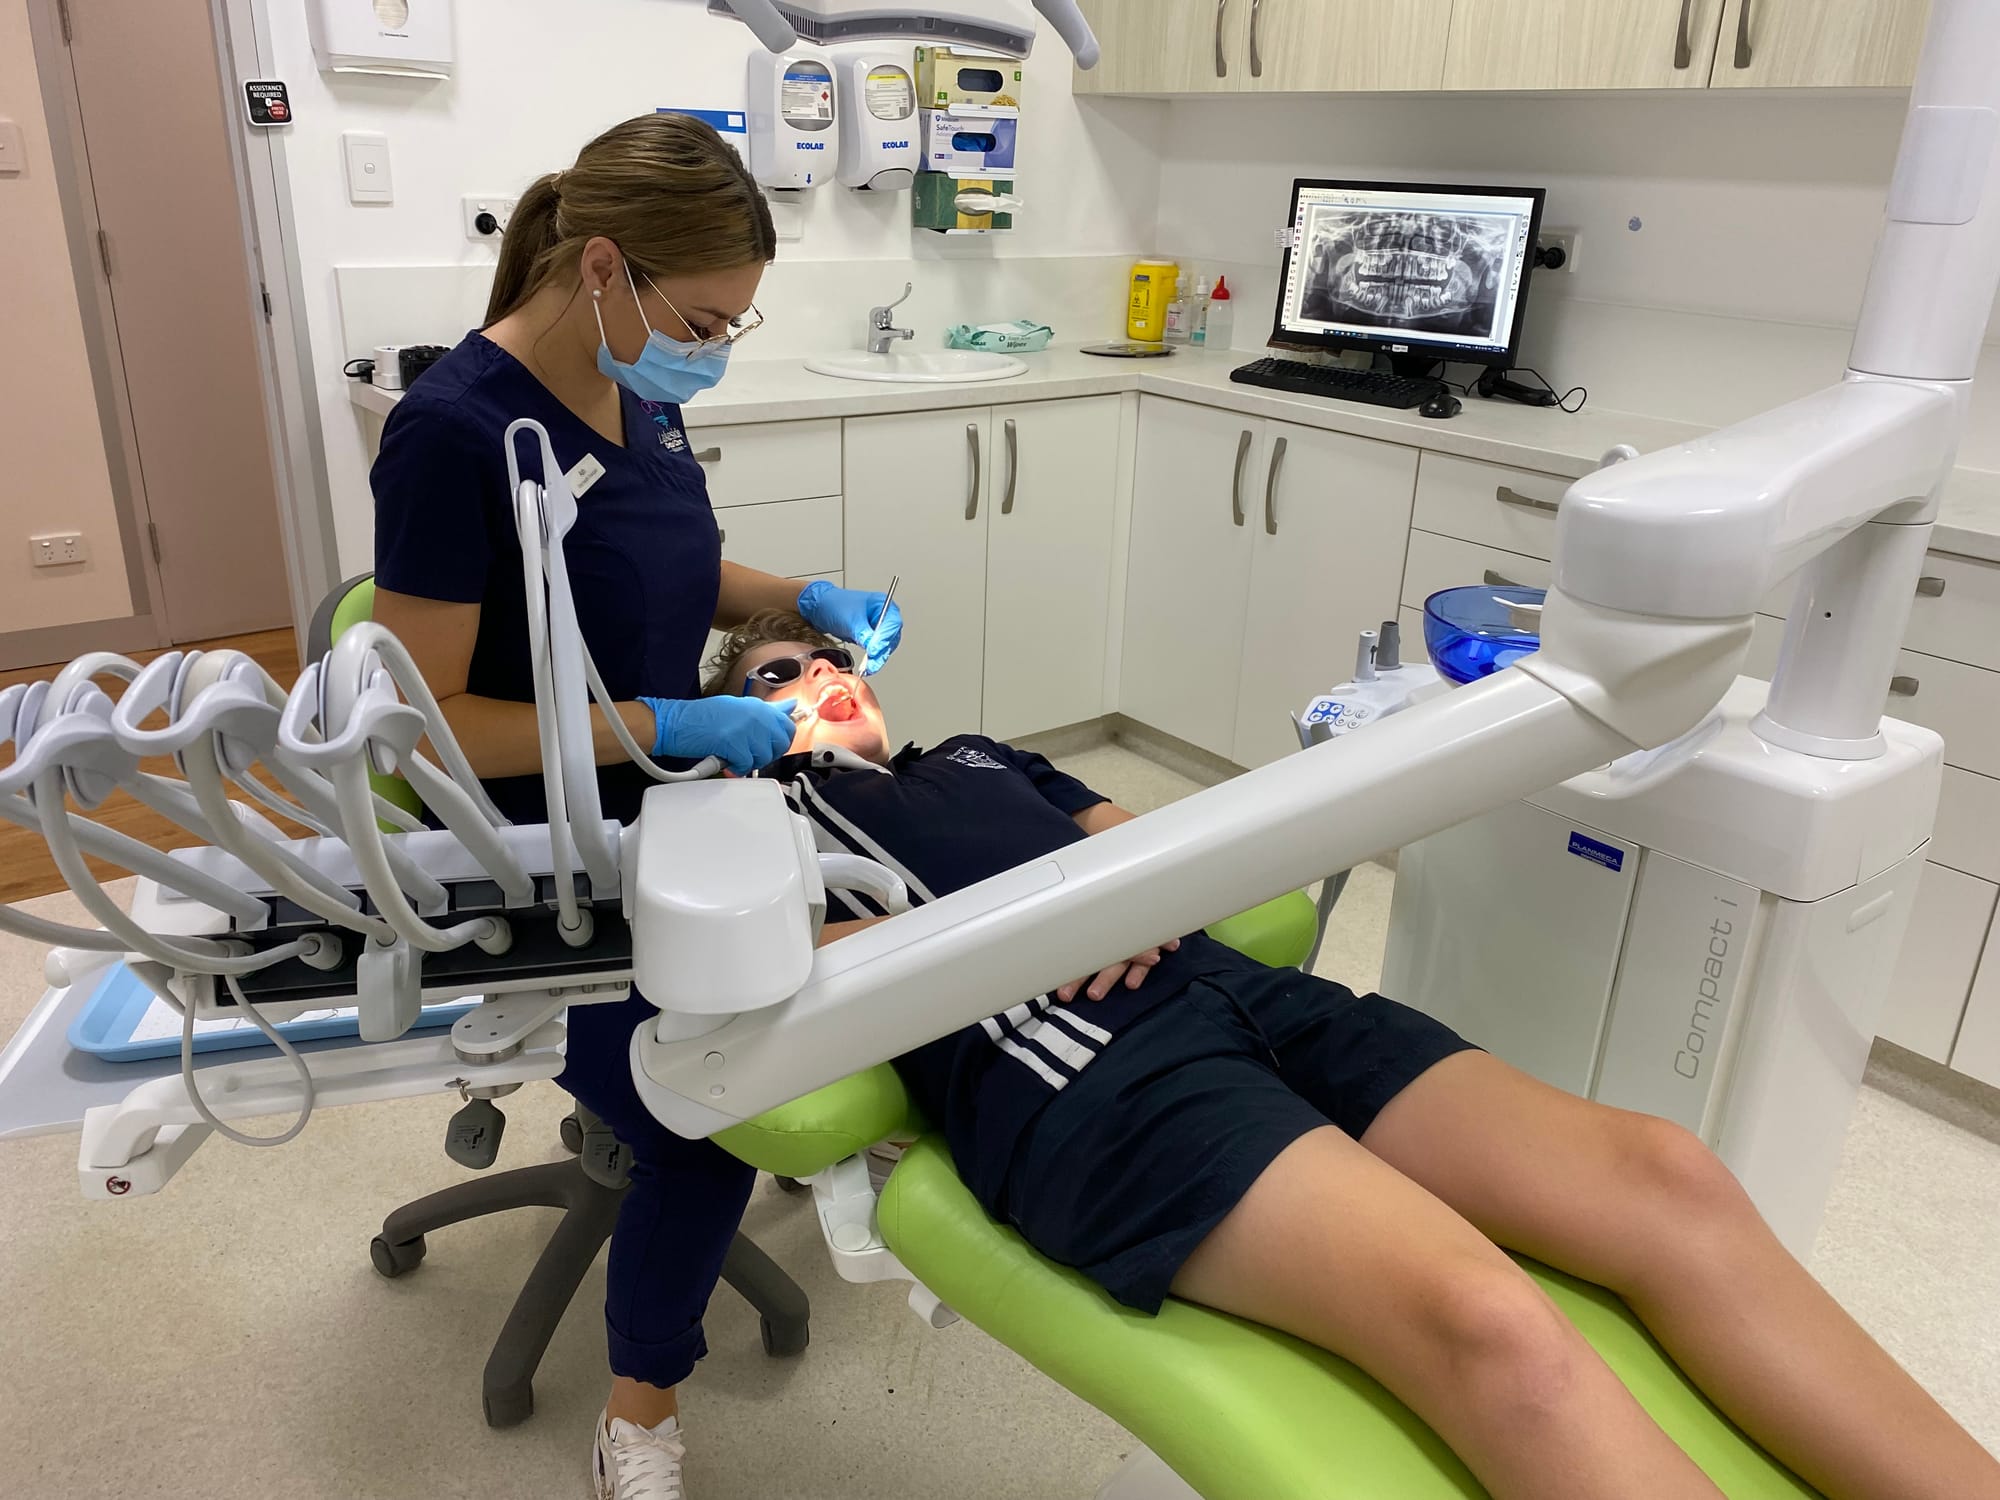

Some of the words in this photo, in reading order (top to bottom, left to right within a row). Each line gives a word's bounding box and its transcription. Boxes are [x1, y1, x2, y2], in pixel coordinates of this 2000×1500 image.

[796, 142, 824, 150] ECOLAB
[882, 141, 908, 149] ECOLAB
[1572, 842, 1618, 864] PLANMECA
[1674, 918, 1732, 1079] Compact
[1714, 896, 1738, 907] i
